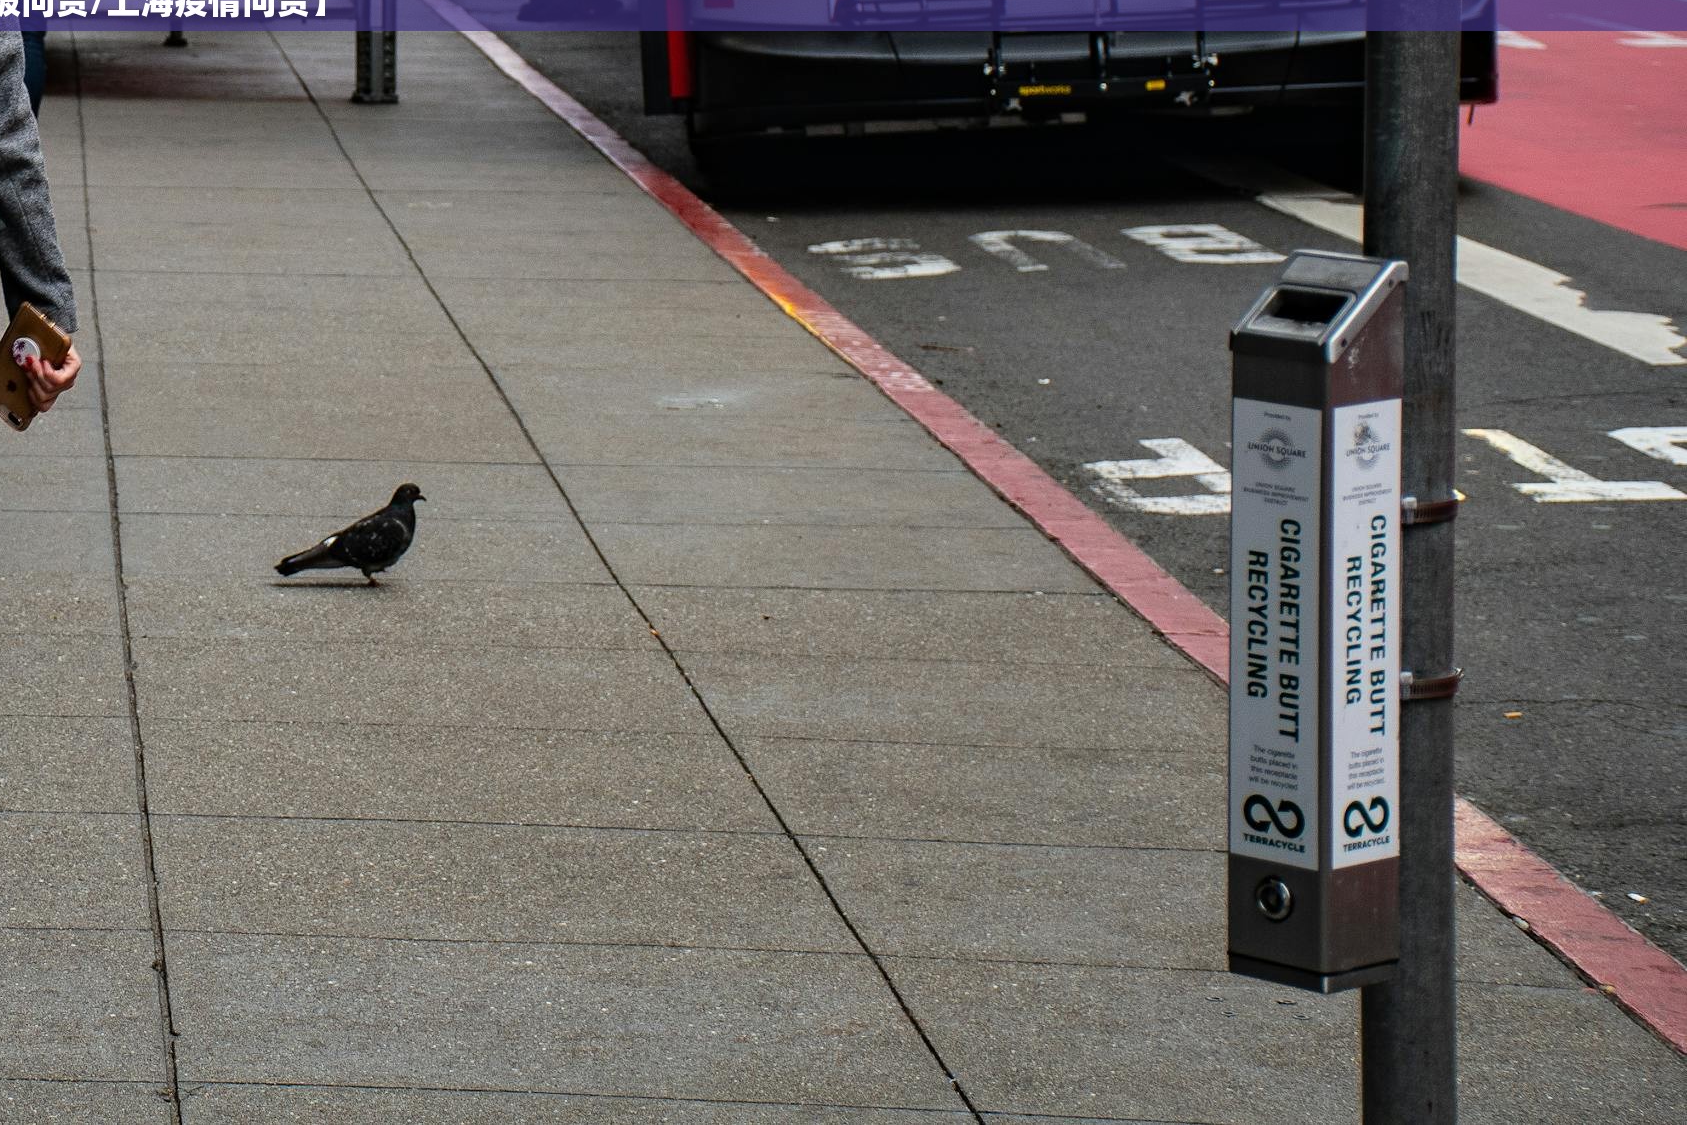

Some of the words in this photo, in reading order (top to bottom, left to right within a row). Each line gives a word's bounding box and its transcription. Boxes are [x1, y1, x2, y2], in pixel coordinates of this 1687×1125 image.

[1248, 441, 1274, 453] UNION
[1275, 446, 1306, 458] SQUARE
[1346, 446, 1366, 457] UNION
[1367, 443, 1391, 455] SQUARE
[1278, 518, 1301, 666] CIGARETTE
[1370, 515, 1387, 661] CIGARETTE
[1247, 550, 1269, 699] RECYCLING
[1346, 555, 1362, 705] RECYCLING
[1278, 673, 1300, 743] BUTT
[1370, 669, 1385, 737] BUTT
[1243, 833, 1306, 853] TERRACYCLE
[1343, 835, 1390, 853] TERRACYCLE
